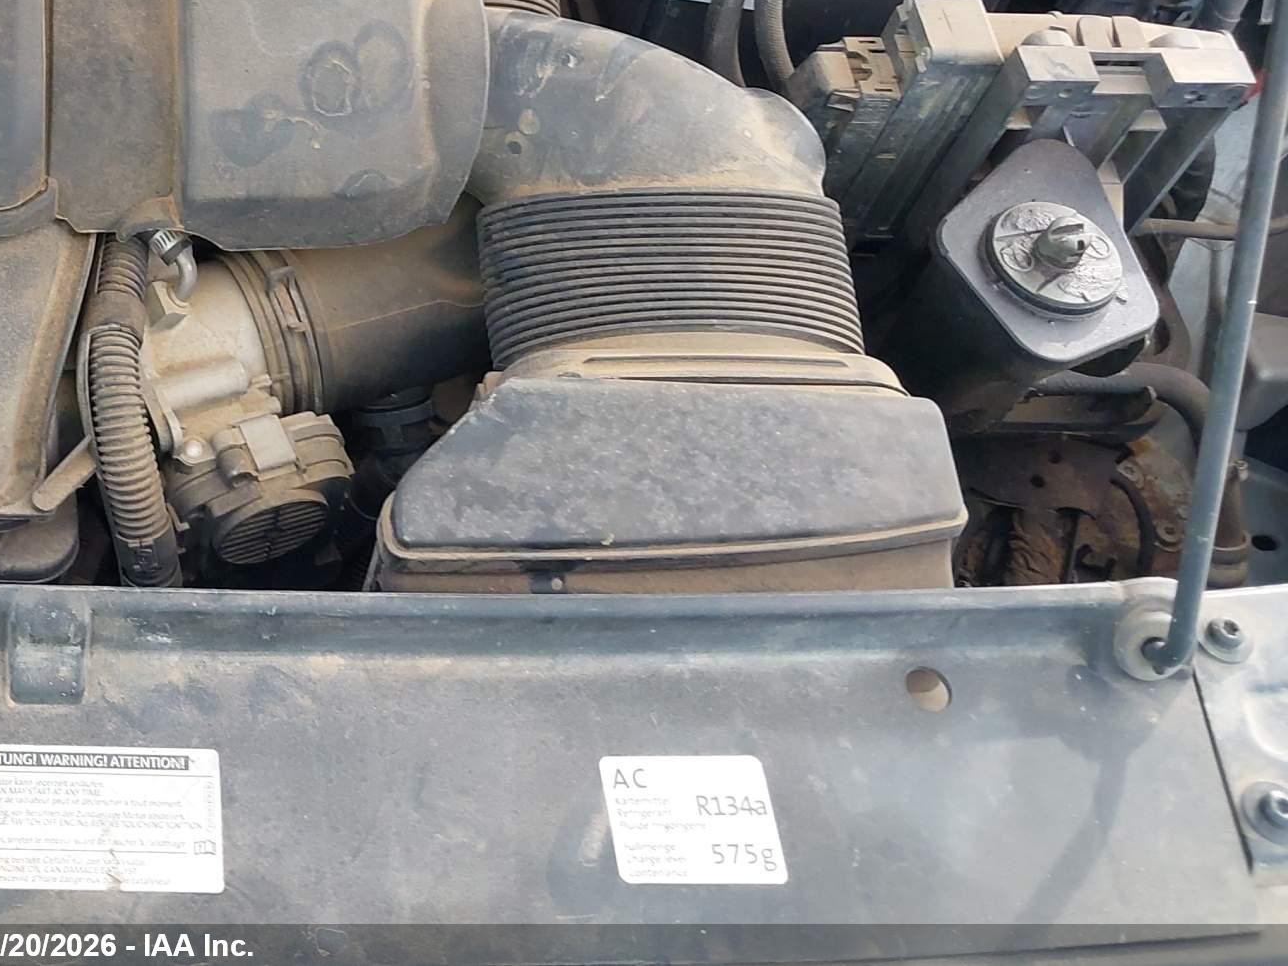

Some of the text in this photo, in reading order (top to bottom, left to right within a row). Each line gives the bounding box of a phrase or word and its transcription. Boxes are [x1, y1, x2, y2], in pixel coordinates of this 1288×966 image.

[39, 753, 108, 769] WARNING!
[110, 755, 186, 770] ATTENTION!
[613, 768, 647, 789] AC
[696, 795, 767, 816] R134a
[711, 843, 778, 872] 575g
